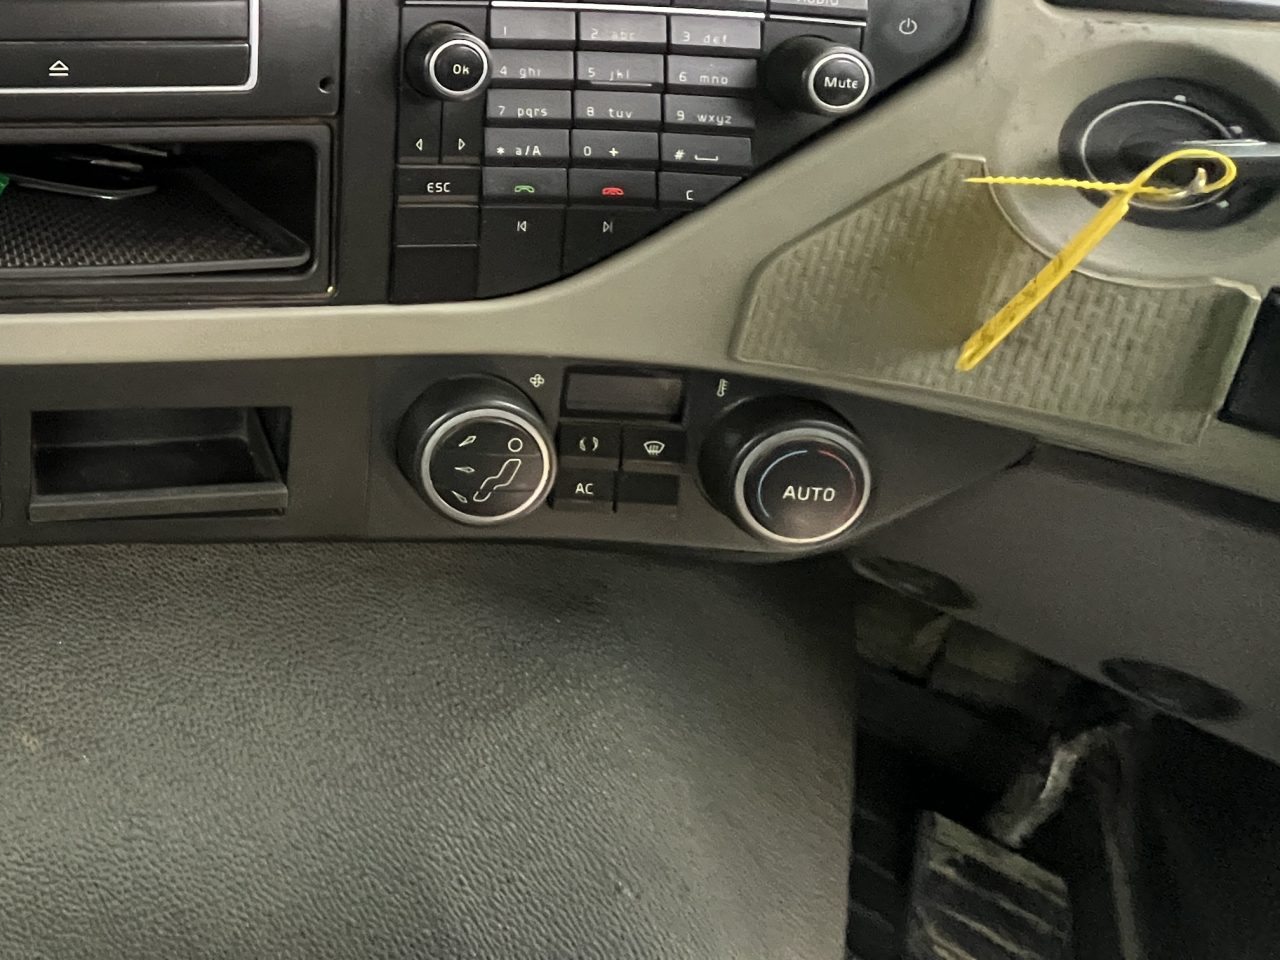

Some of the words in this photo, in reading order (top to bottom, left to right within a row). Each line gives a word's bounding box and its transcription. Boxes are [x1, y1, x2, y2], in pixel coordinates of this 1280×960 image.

[590, 28, 599, 40] 2
[683, 31, 691, 42] 3
[452, 63, 470, 75] Ok
[499, 65, 508, 76] 4
[588, 67, 596, 78] 5
[679, 71, 687, 82] 6
[700, 74, 729, 85] mno
[824, 76, 859, 89] Mute
[498, 105, 506, 116] 7
[517, 106, 548, 118] pqrs
[586, 106, 595, 117] 8
[608, 108, 633, 119] tuv
[676, 109, 686, 121] 9
[696, 113, 733, 126] wxyz
[515, 145, 542, 157] a/A
[426, 182, 451, 193] ESC
[686, 189, 694, 200] C
[575, 482, 594, 495] AC
[782, 485, 836, 502] AUTO
